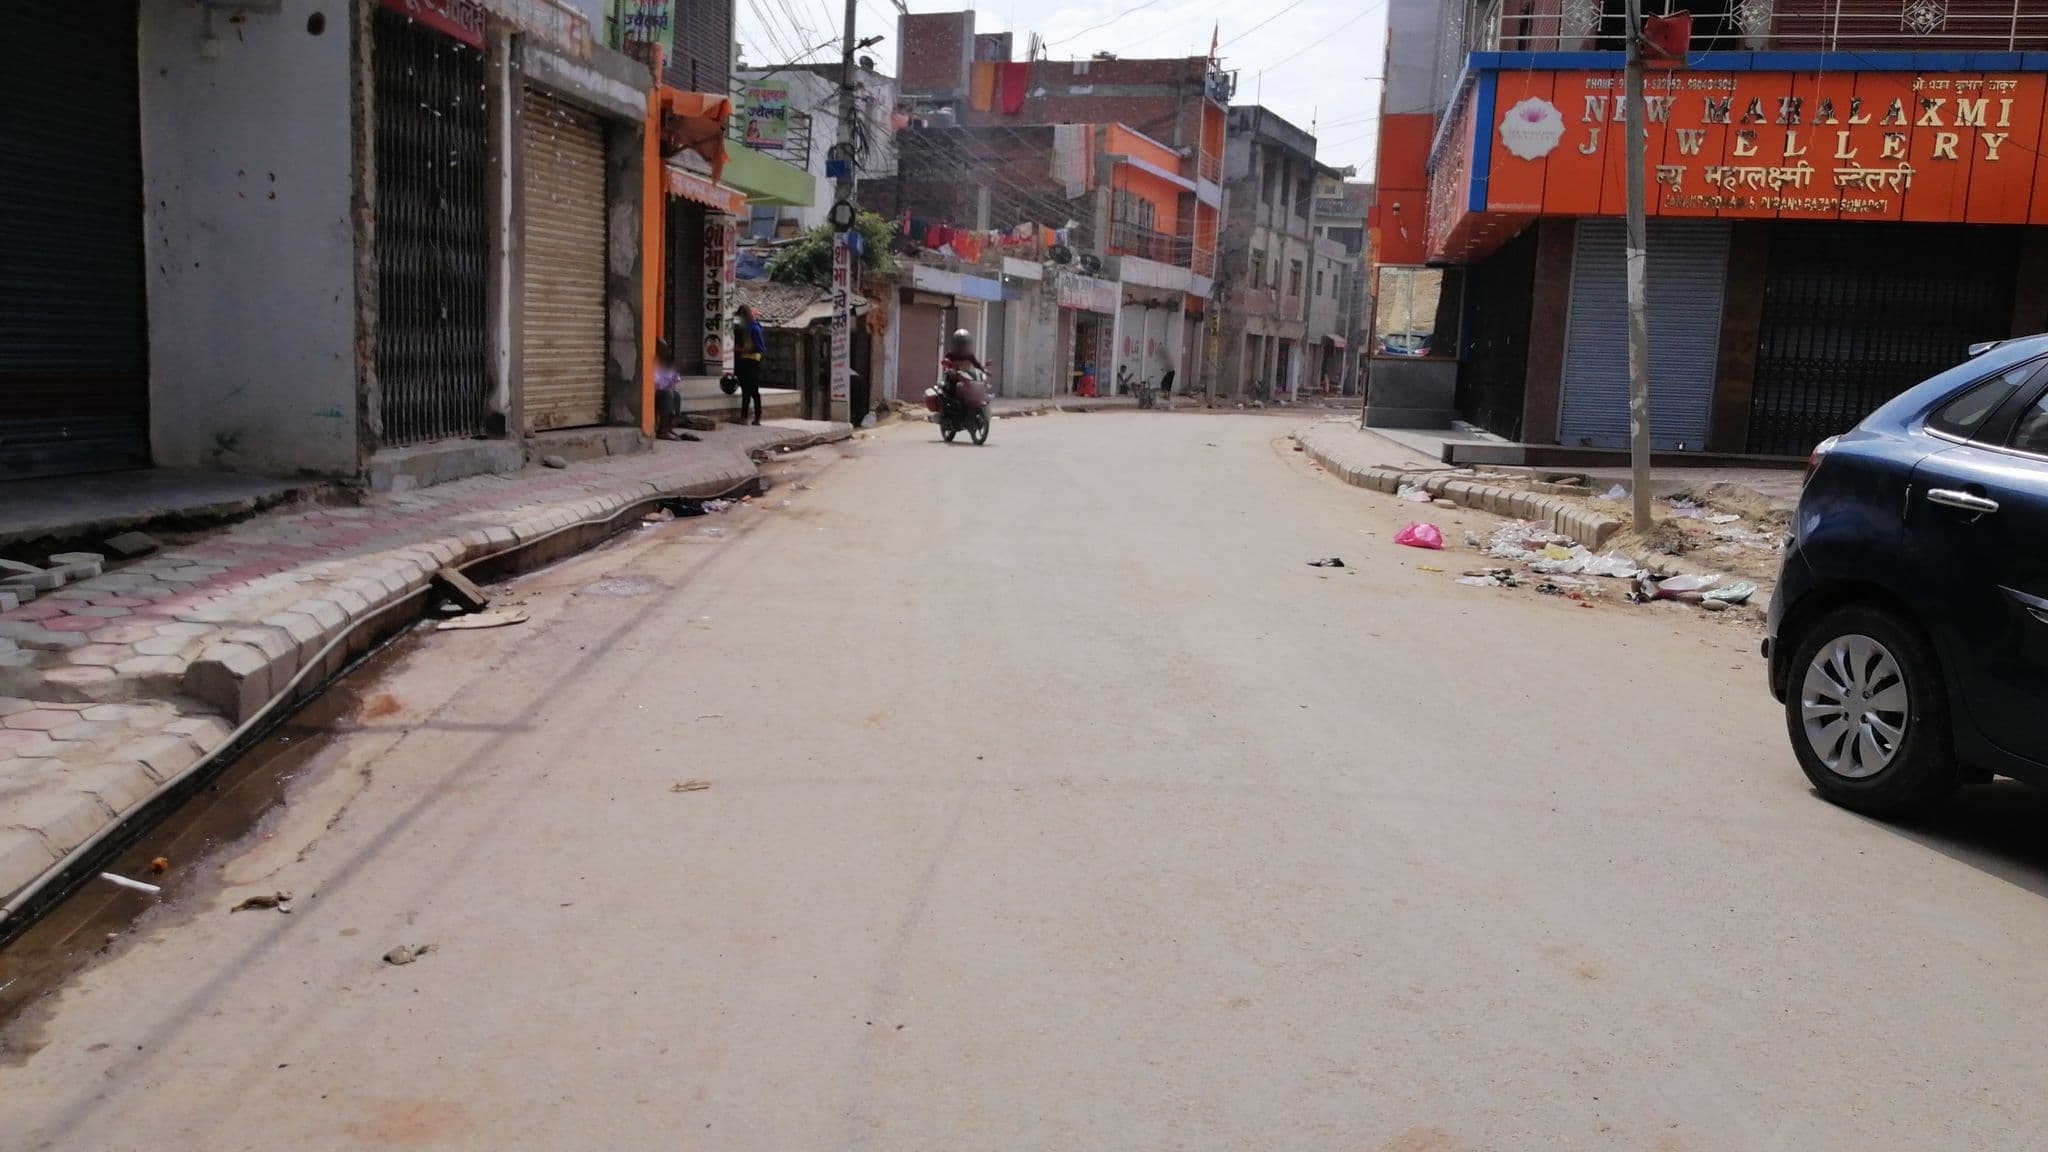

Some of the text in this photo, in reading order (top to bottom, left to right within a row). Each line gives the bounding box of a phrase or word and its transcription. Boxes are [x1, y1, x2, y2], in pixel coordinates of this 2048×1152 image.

[1585, 78, 1614, 90] PHONE
[1656, 164, 1687, 192] न्यू
[1703, 160, 1815, 192] महालक्ष्मी
